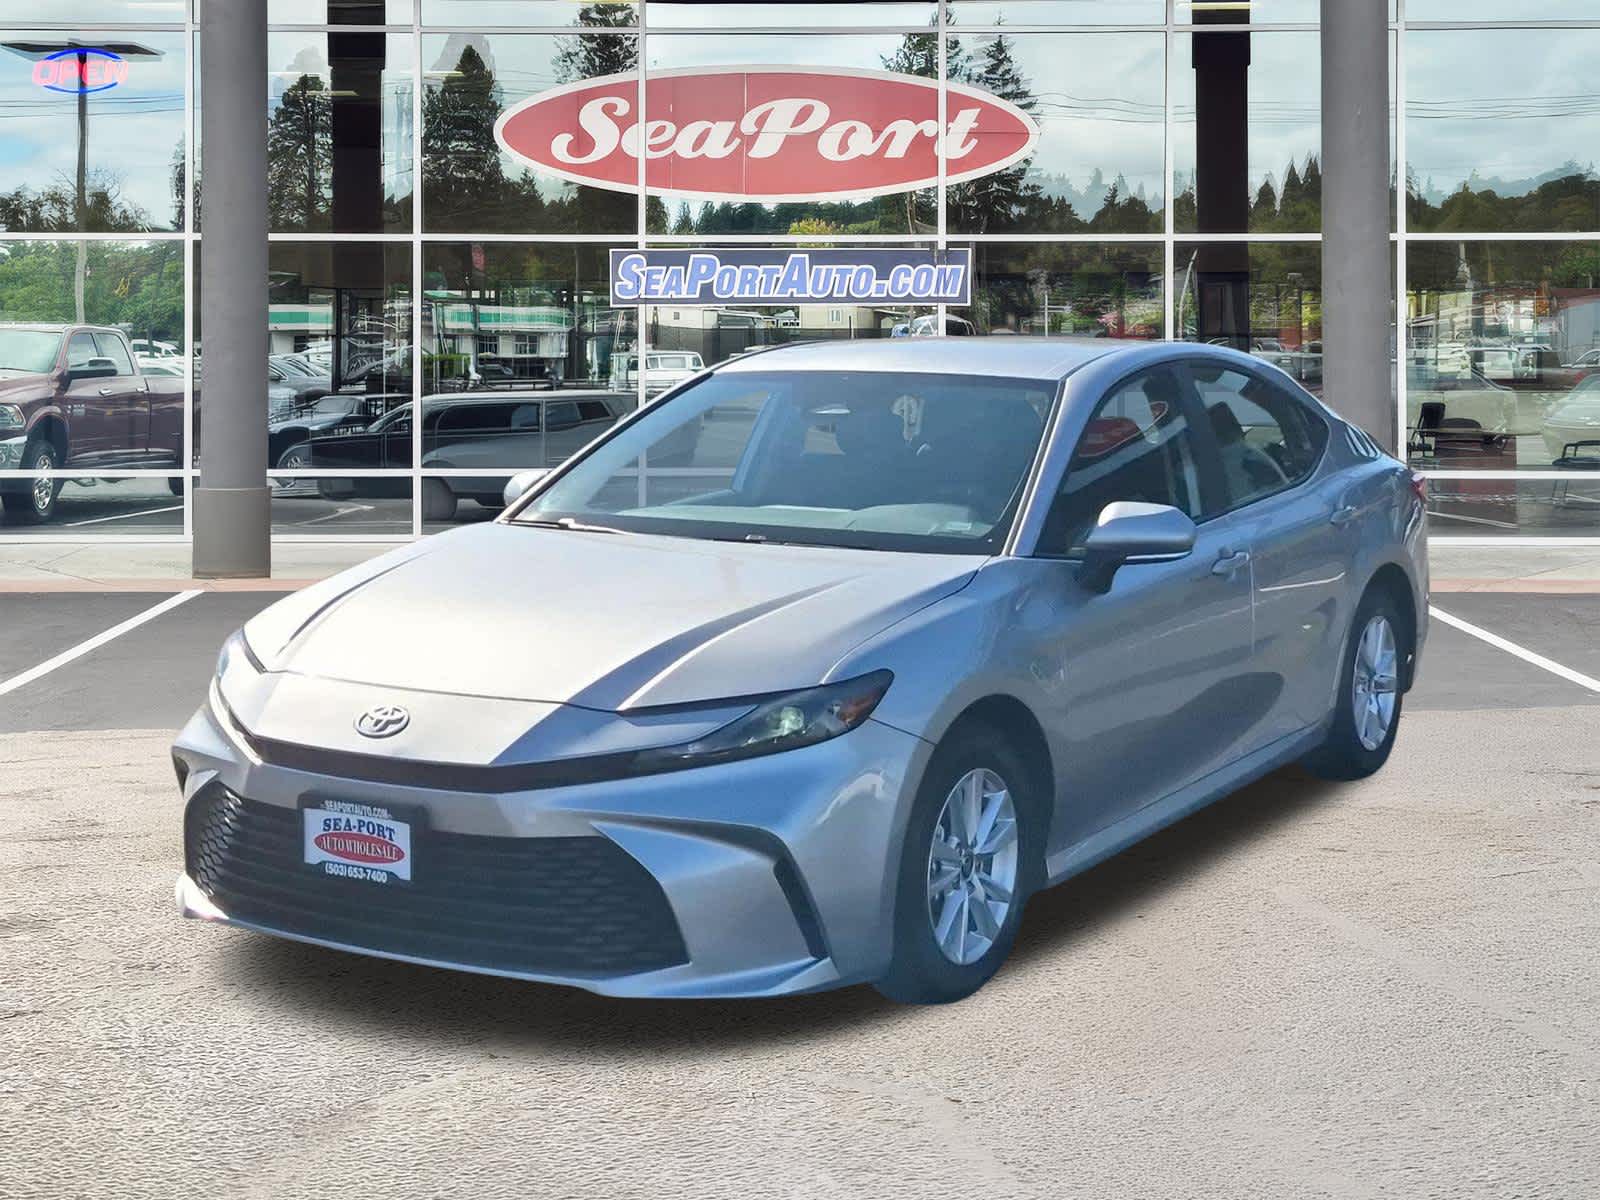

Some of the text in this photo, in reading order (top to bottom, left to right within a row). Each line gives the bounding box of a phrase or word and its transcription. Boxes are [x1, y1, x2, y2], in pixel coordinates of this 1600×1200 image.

[32, 59, 128, 86] OPEN
[550, 96, 982, 164] SeaPort
[322, 818, 396, 841] SEA-PORT
[325, 863, 387, 883] (503) 653-7400
